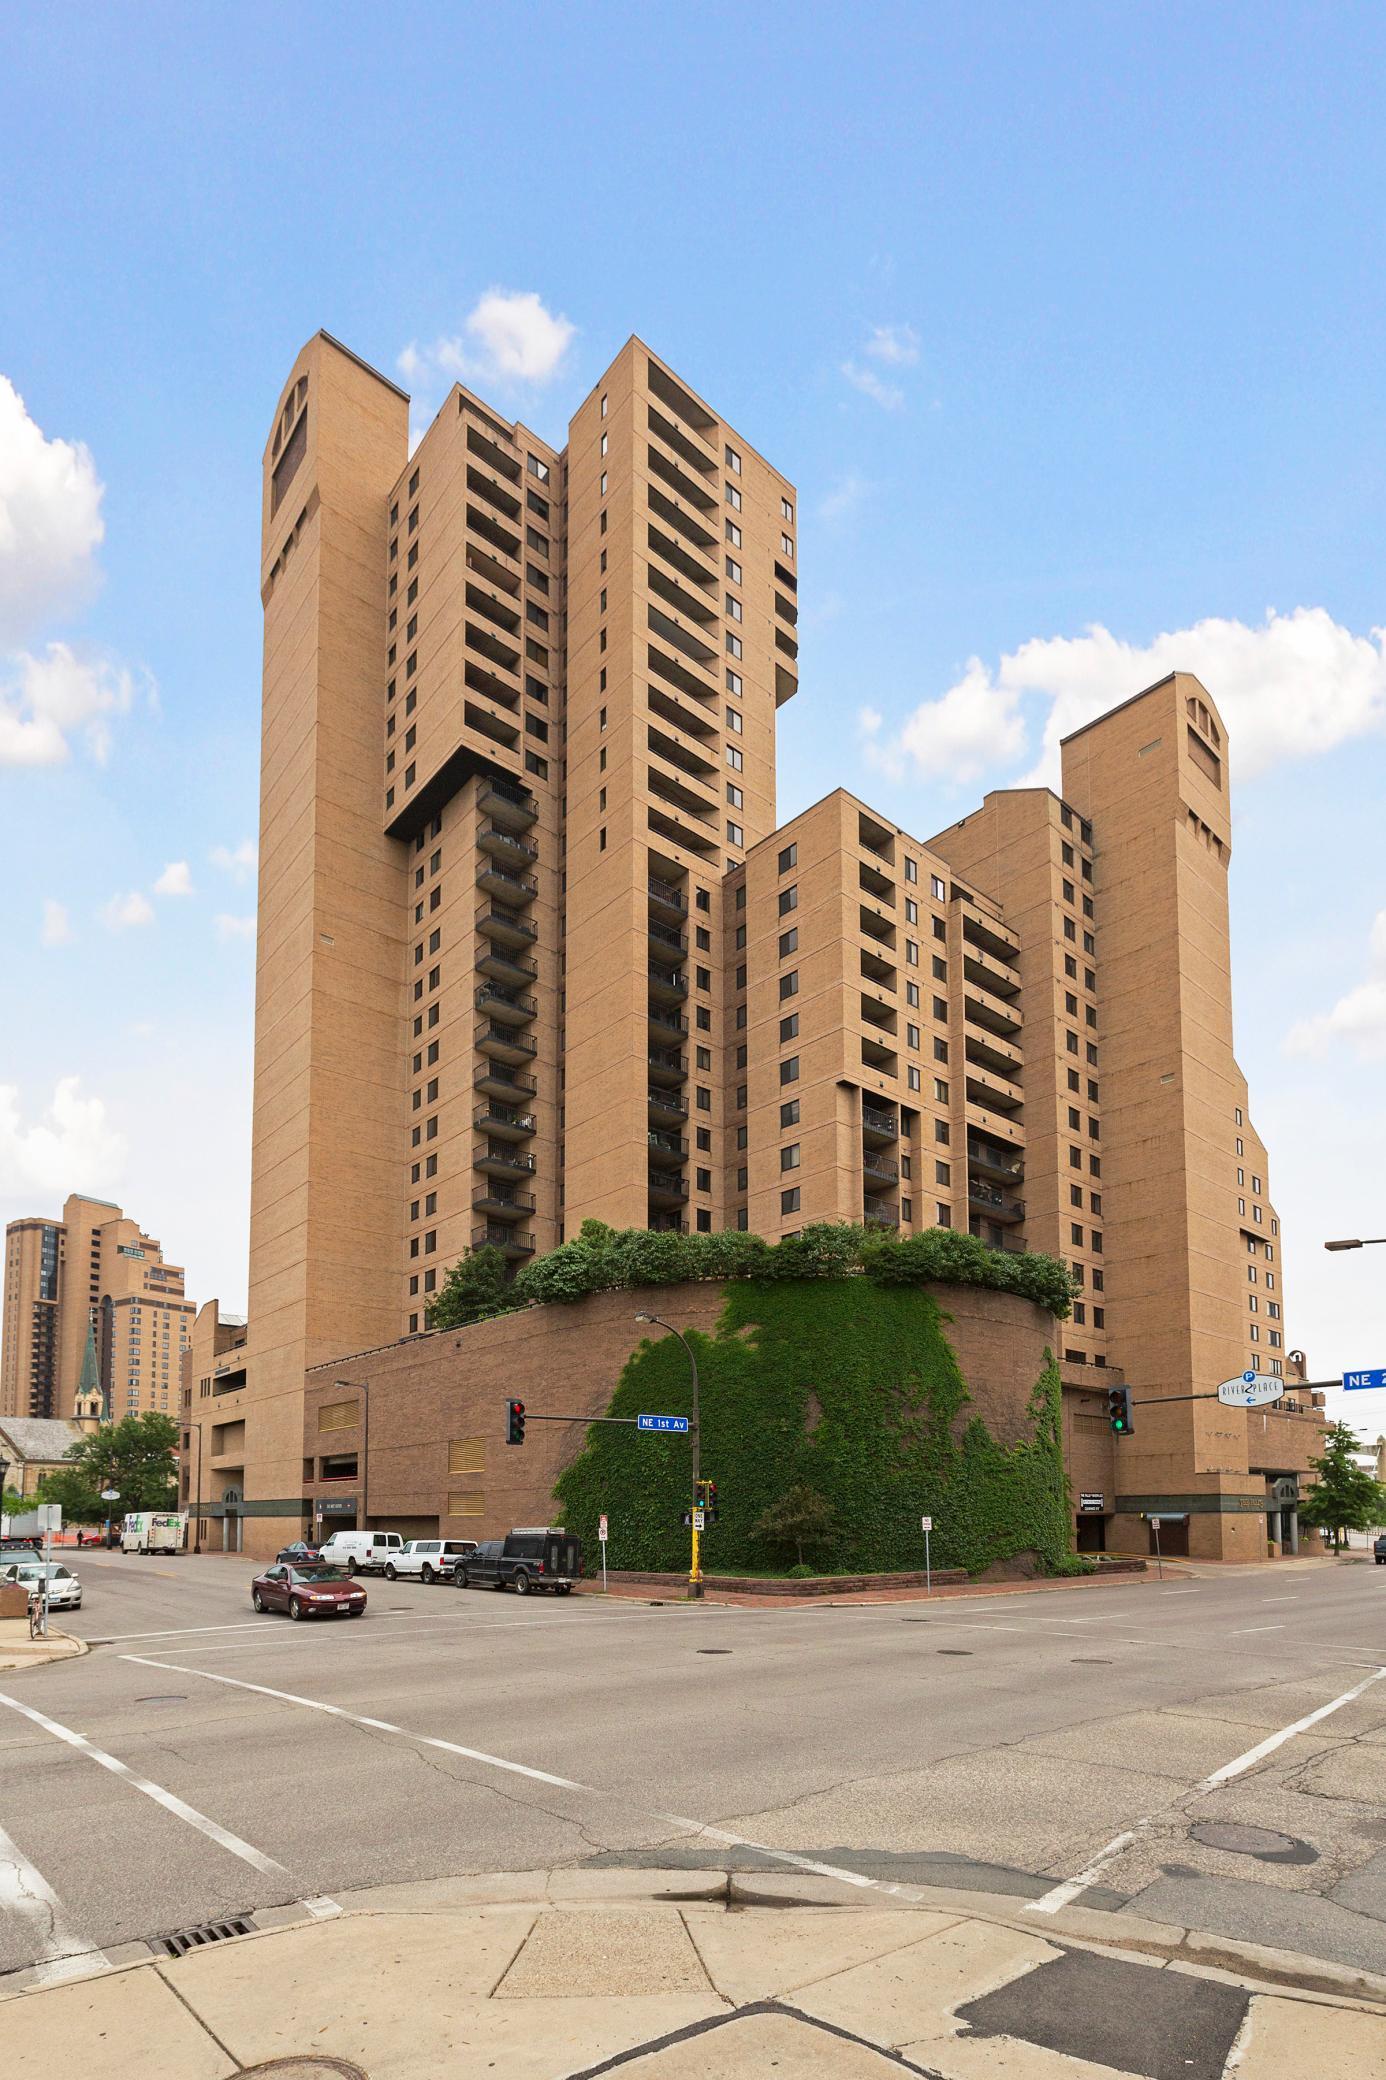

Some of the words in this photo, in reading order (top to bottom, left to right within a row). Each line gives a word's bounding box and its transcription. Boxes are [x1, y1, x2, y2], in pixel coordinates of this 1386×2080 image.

[1245, 1373, 1253, 1381] P
[1349, 1374, 1371, 1386] NE
[1222, 1385, 1245, 1396] RIVER
[1253, 1382, 1278, 1392] PLACE
[642, 1418, 653, 1427] NE
[657, 1419, 669, 1428] 1st
[673, 1420, 684, 1429] Av
[151, 1517, 181, 1528] FedEx
